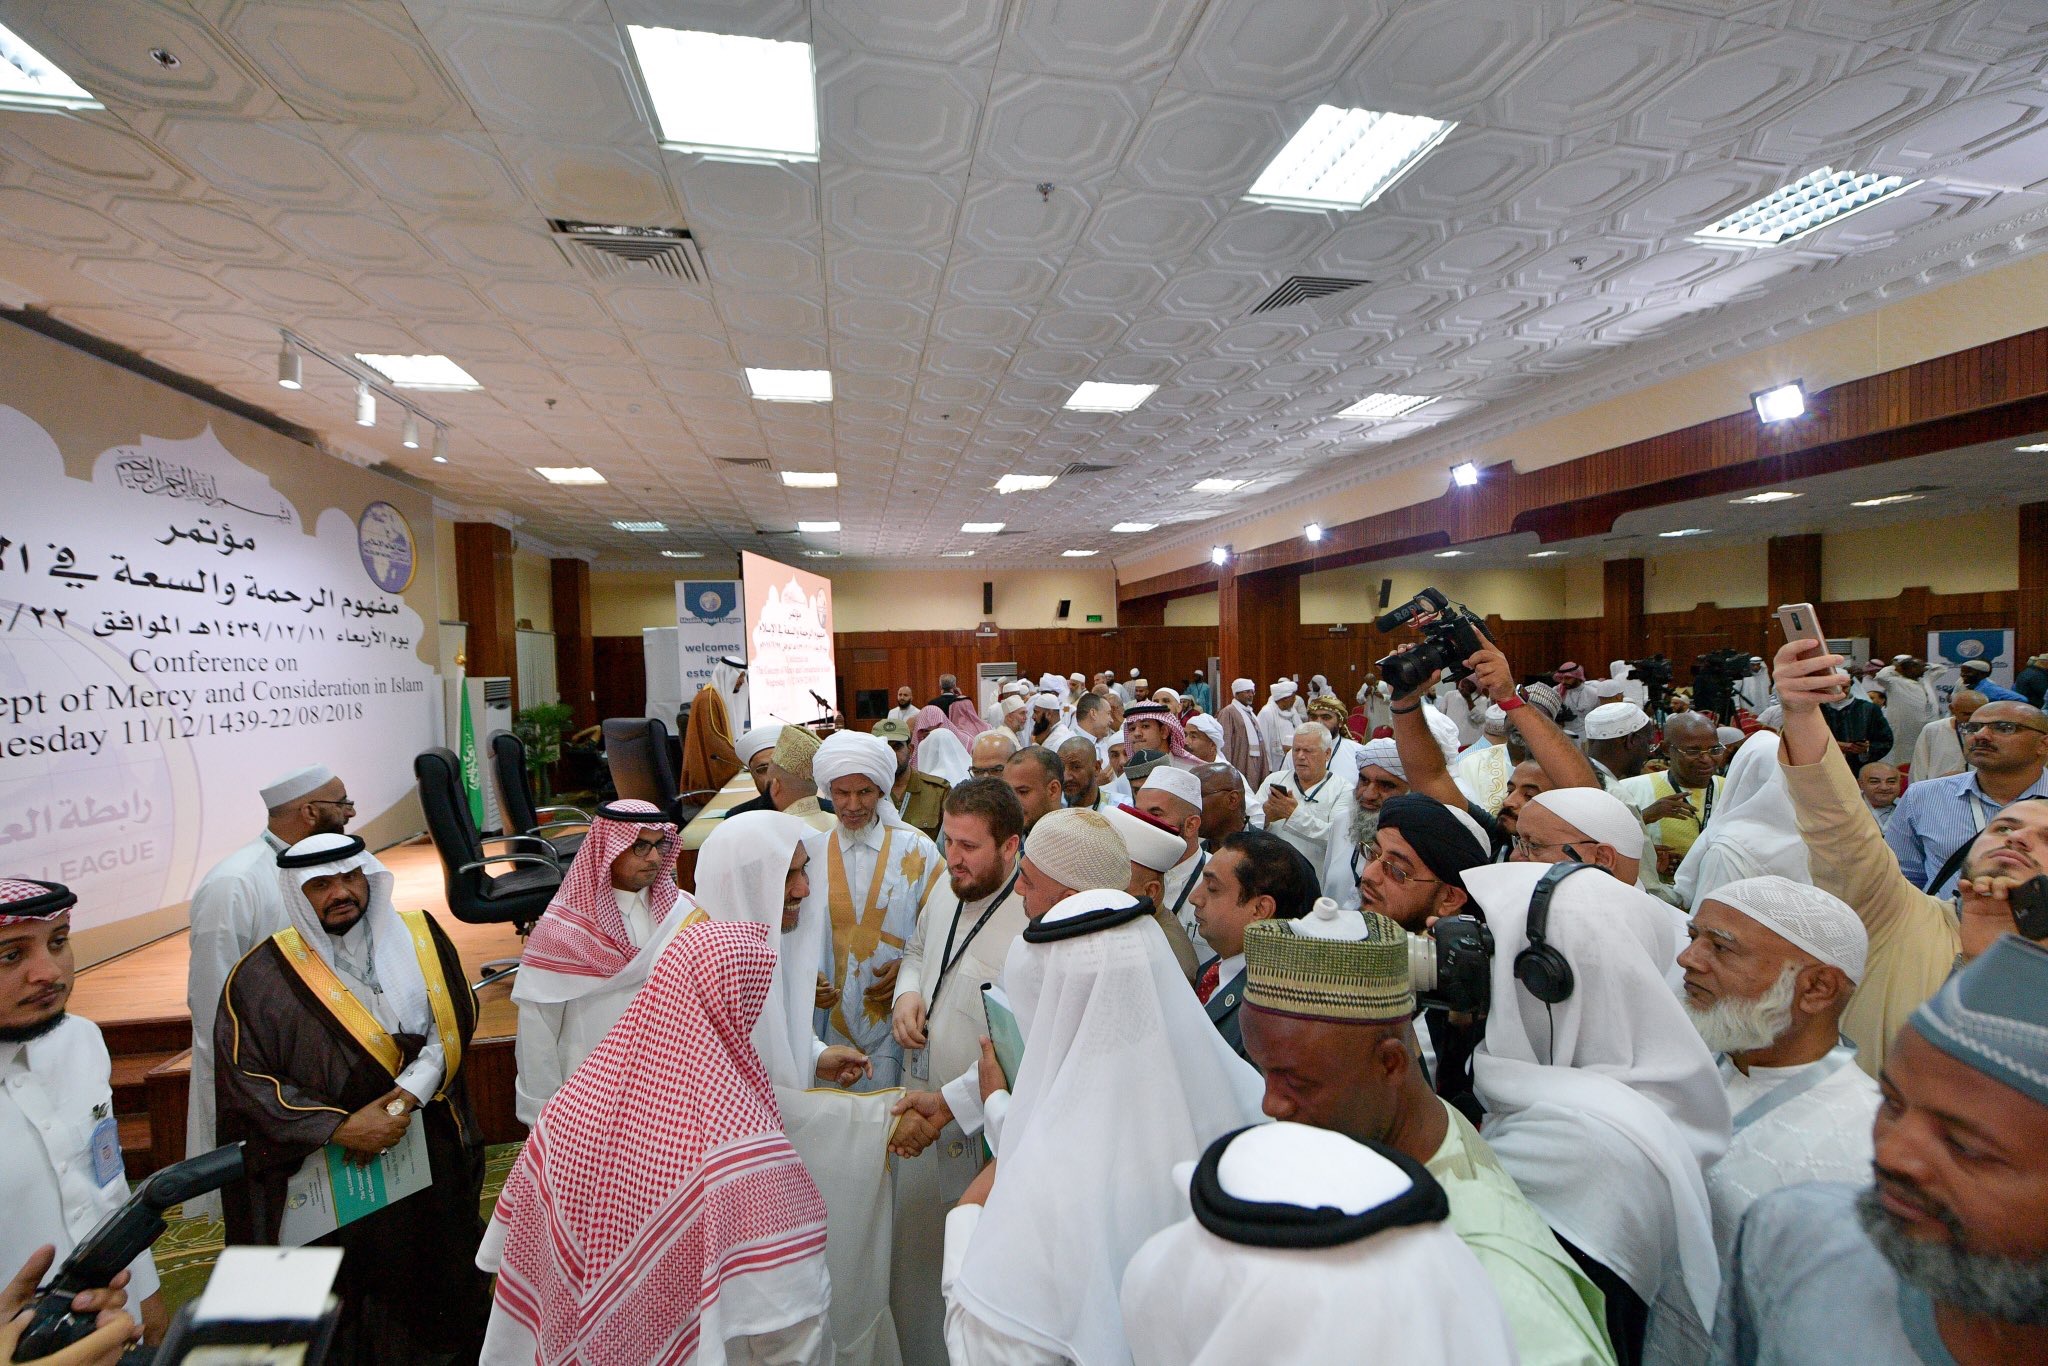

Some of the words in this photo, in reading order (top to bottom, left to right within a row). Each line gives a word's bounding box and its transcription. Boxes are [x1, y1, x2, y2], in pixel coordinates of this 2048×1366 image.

[154, 518, 255, 556] مؤتمر
[47, 543, 98, 589] في
[110, 554, 236, 606] والسعة
[243, 574, 334, 613] الرحمة
[341, 595, 399, 618] مفهوم
[92, 609, 180, 640] الموافق
[336, 625, 387, 648] الأربعاء
[389, 633, 409, 650] يوم
[685, 642, 740, 653] welcomes
[129, 648, 268, 674] Conference
[275, 656, 298, 672] on
[686, 669, 713, 678] este
[706, 655, 720, 664] its
[60, 684, 98, 713] of
[104, 684, 196, 712] Mercy
[205, 681, 245, 704] and
[253, 678, 370, 702] Consideration
[374, 677, 387, 694] in
[390, 676, 424, 694] Islam
[0, 724, 108, 760] esday
[59, 788, 152, 832] رابطة
